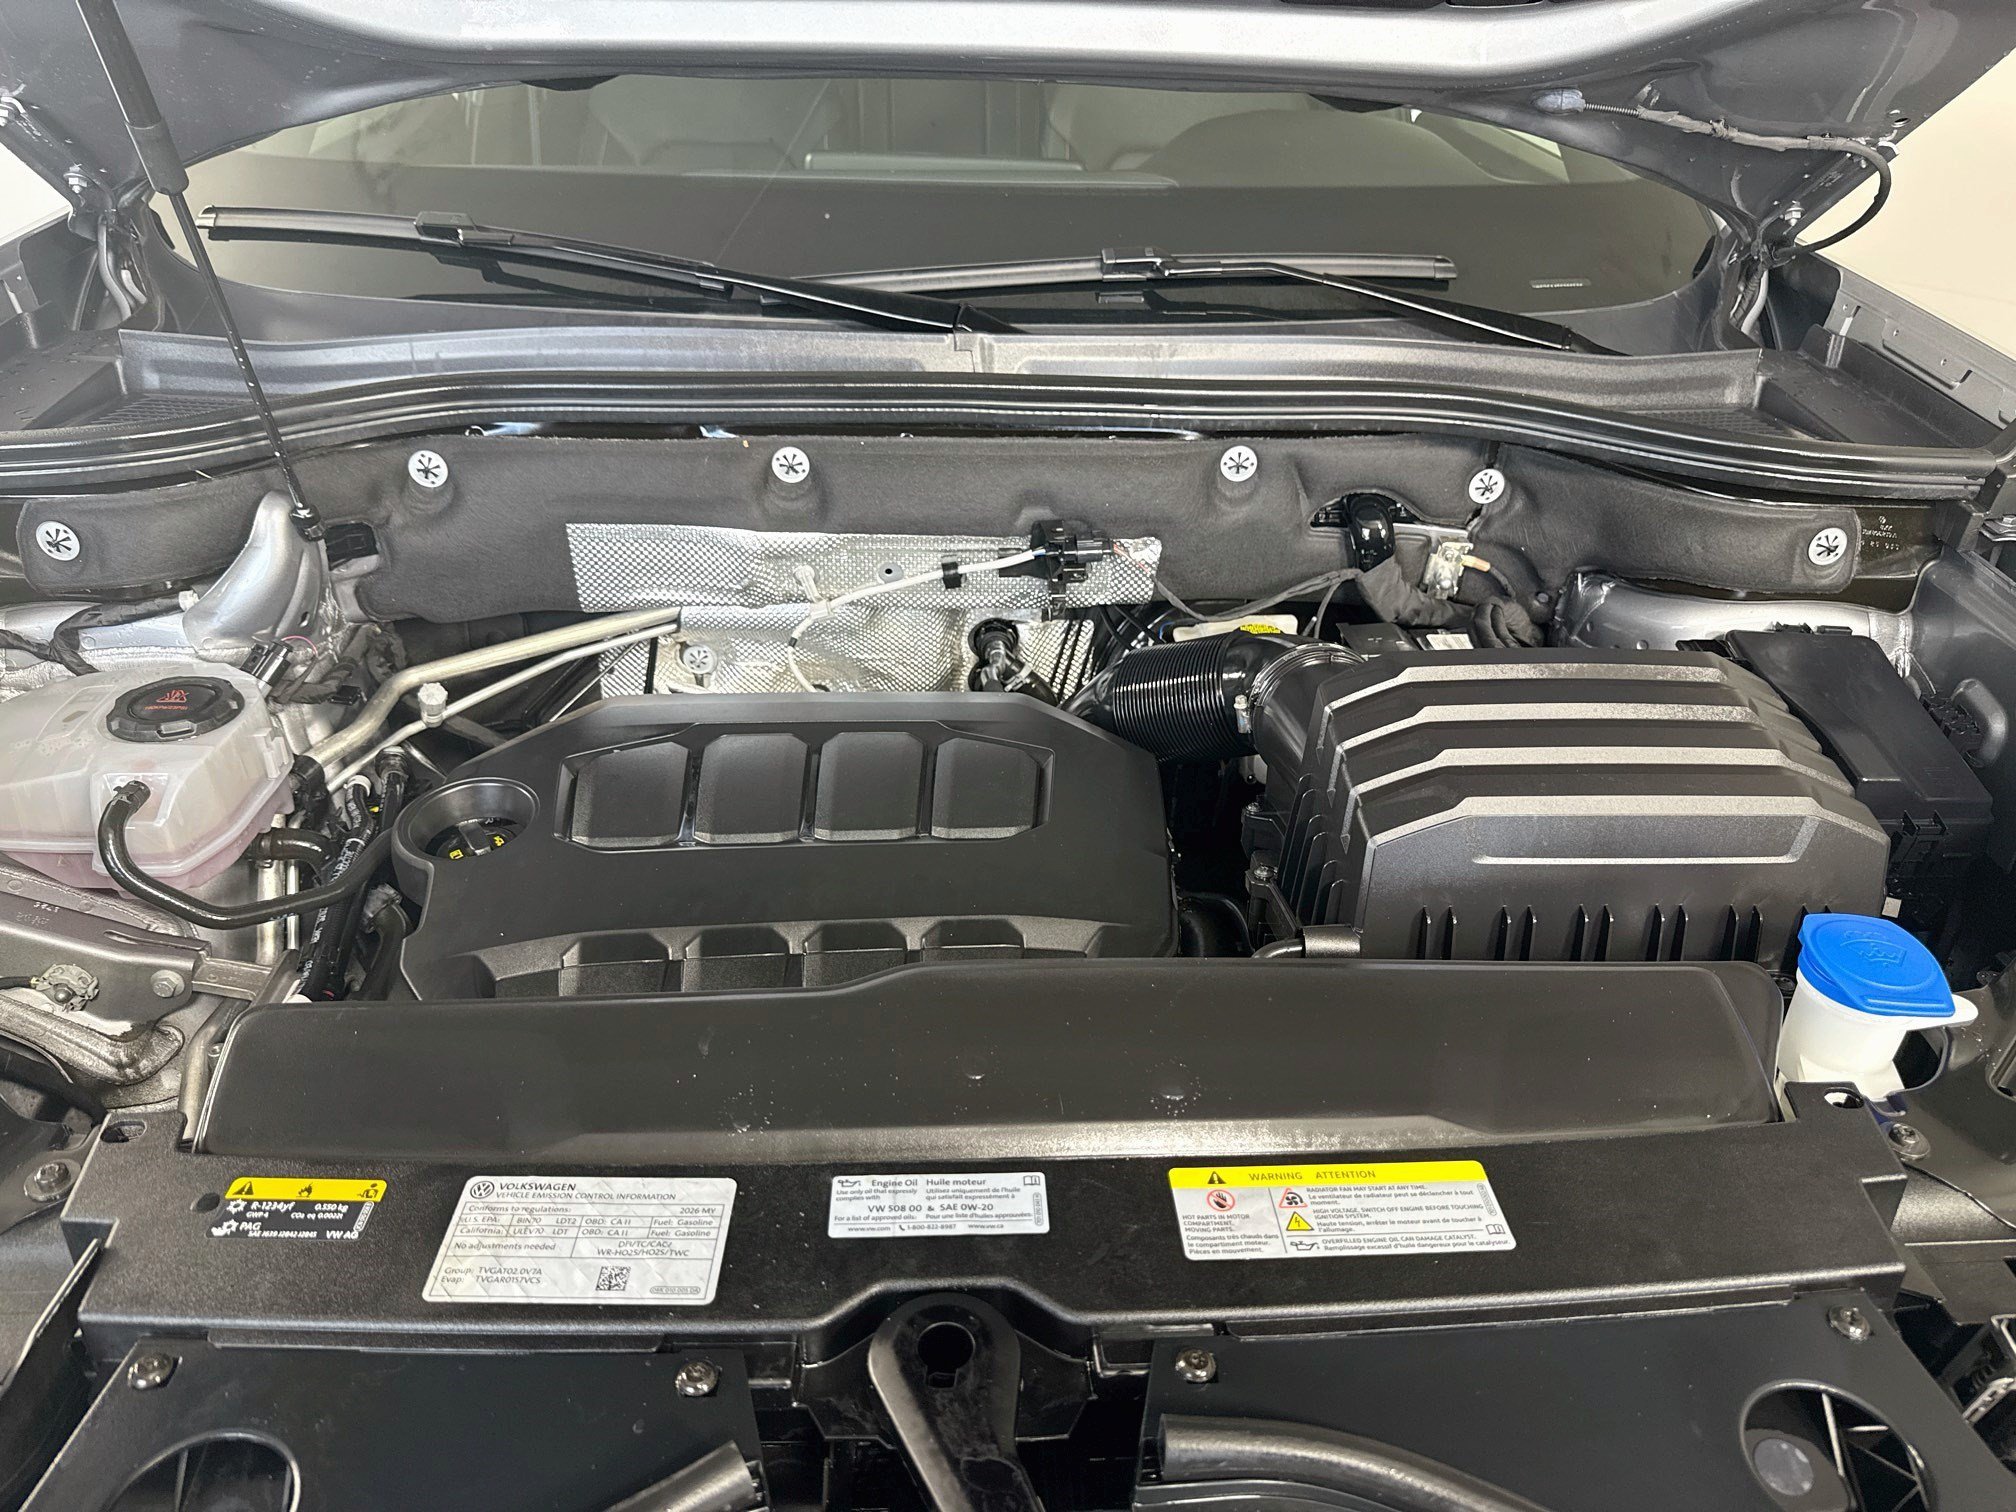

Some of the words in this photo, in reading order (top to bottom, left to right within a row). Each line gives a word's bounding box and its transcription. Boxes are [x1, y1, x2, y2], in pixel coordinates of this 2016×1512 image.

[1249, 1172, 1303, 1180] WARNING
[1315, 1170, 1376, 1179] ATTENTION
[499, 1182, 577, 1191] VOLKSWAGEN
[871, 1179, 903, 1188] Engine
[926, 1178, 950, 1186] Huile
[251, 1201, 296, 1212] R-1234yf
[338, 1204, 349, 1213] kg
[240, 1222, 262, 1230] PAG
[326, 1230, 343, 1239] VW
[343, 1231, 359, 1239] AG
[468, 1242, 522, 1250] adjustments
